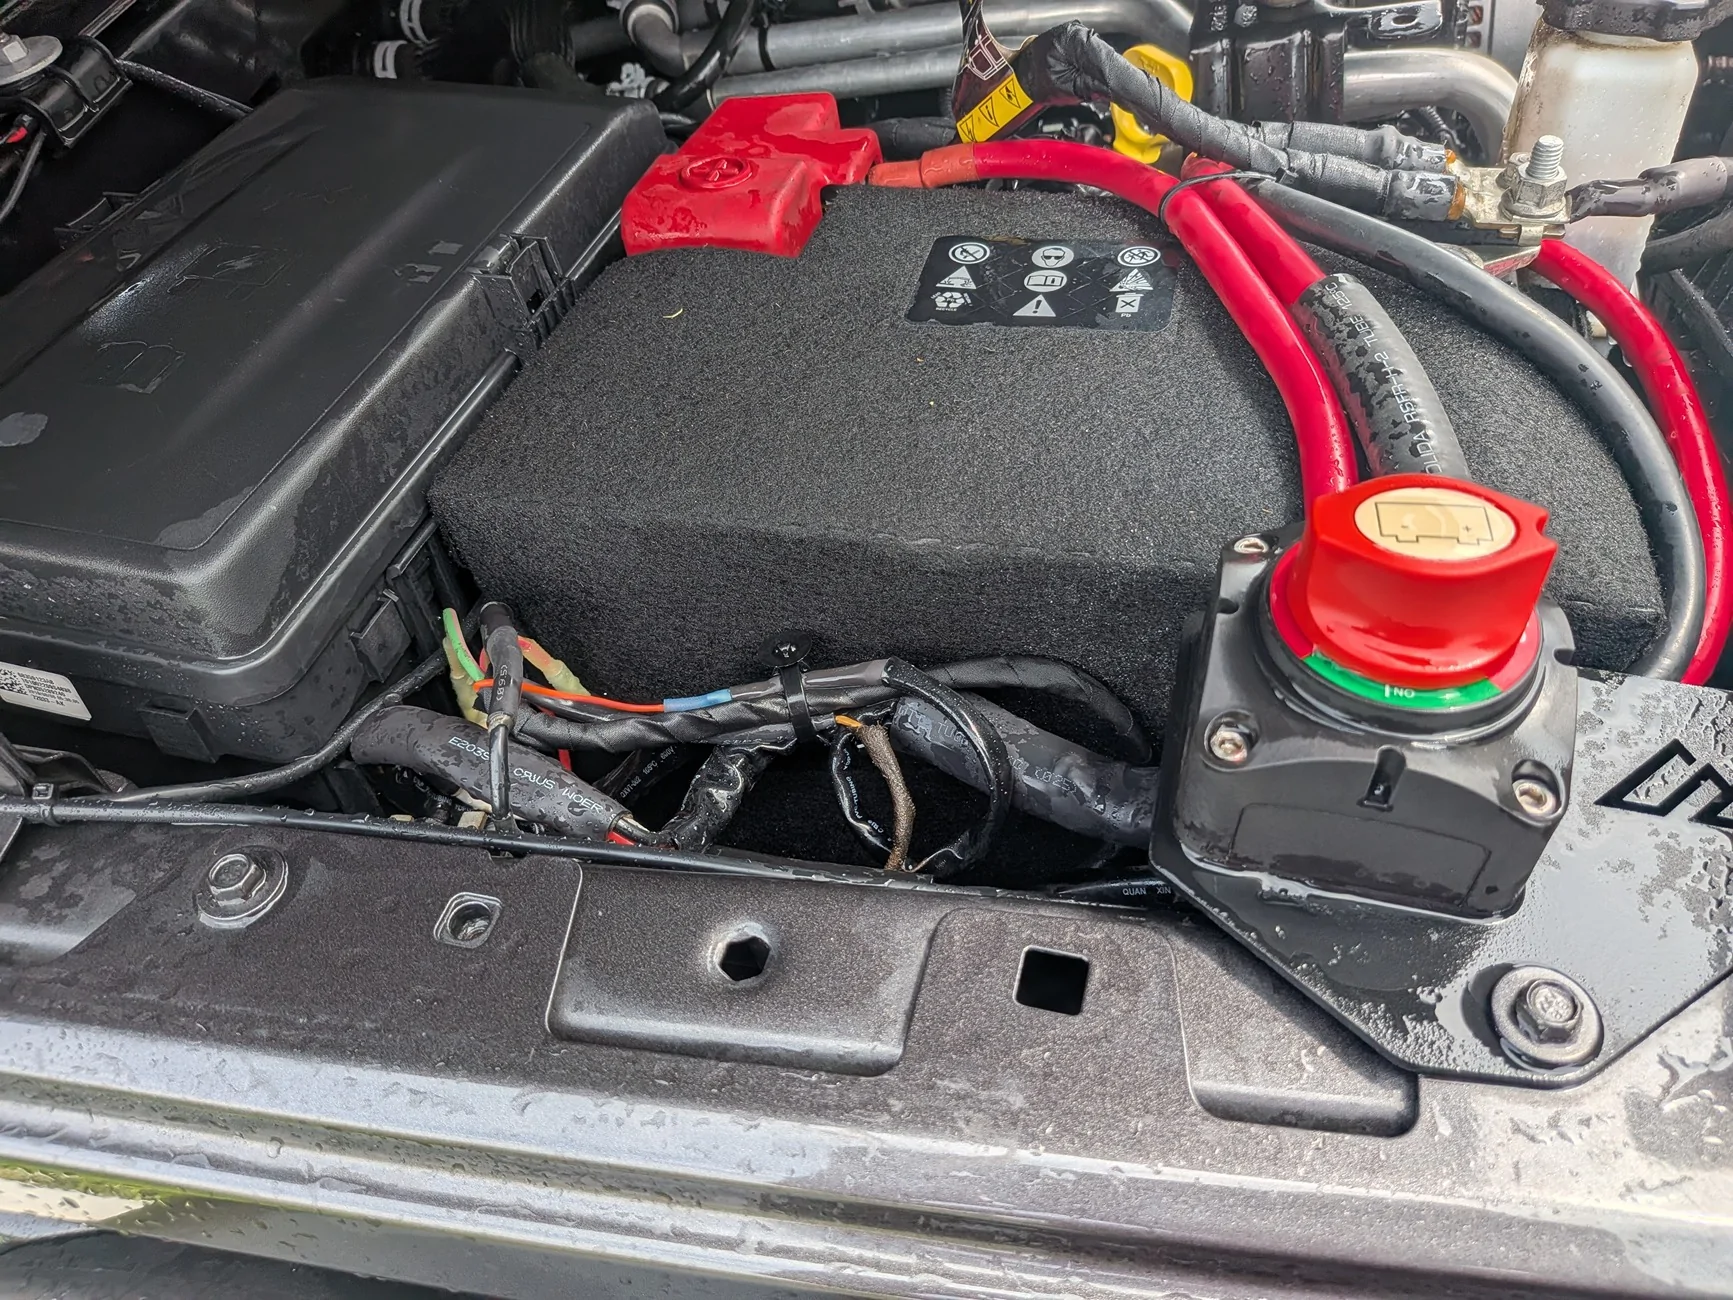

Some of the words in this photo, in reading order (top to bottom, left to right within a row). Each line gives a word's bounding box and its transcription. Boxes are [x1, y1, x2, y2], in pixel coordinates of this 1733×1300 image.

[1350, 313, 1379, 348] TUBE
[561, 787, 604, 817] WOER
[1122, 887, 1147, 896] QUAN
[1155, 886, 1172, 895] XIN
